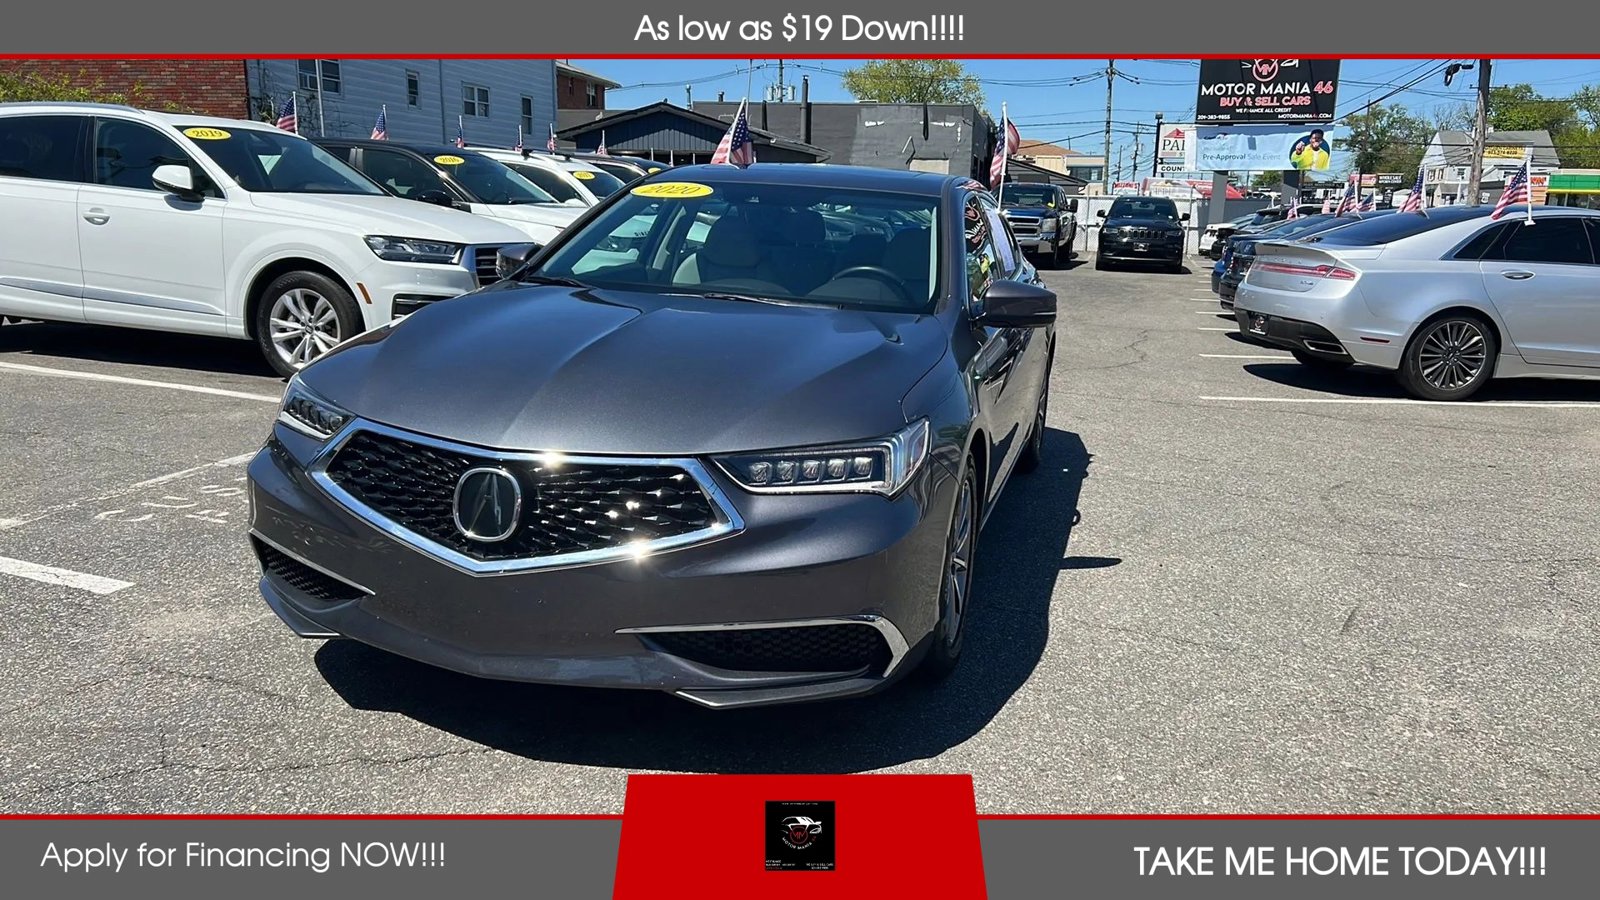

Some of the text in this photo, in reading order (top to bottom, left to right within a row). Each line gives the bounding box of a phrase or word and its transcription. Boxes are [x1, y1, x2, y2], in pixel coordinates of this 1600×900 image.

[1201, 80, 1334, 96] MOTOR MANIA 46
[1219, 97, 1243, 107] BUY
[1254, 97, 1280, 107] SELL
[1281, 95, 1312, 106] CARS
[1202, 153, 1246, 161] Pre-Approval
[640, 185, 701, 195] 2020
